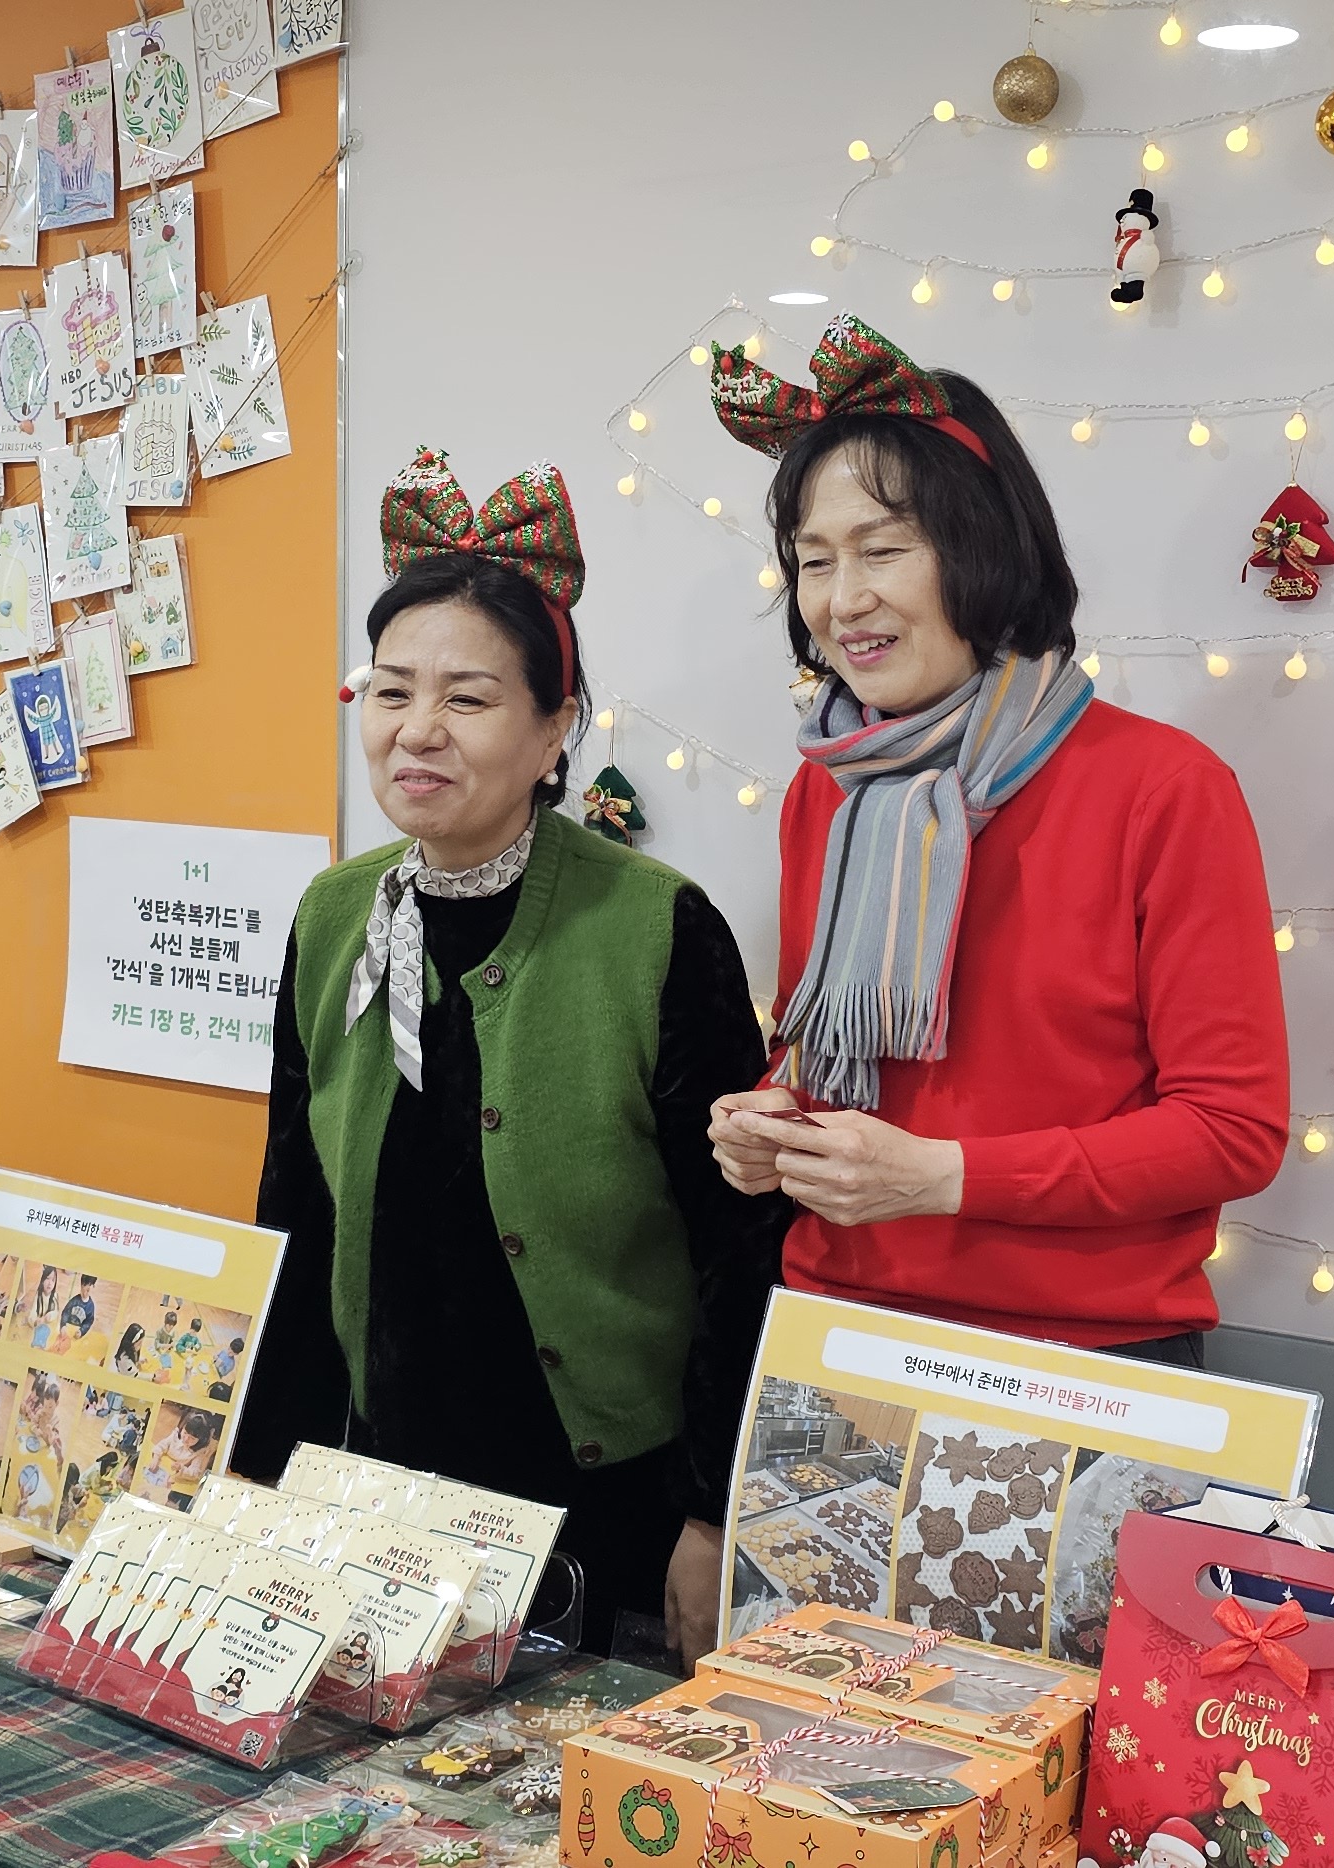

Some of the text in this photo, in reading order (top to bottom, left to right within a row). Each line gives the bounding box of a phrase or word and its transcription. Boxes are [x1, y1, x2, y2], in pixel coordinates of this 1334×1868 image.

[203, 46, 269, 94] CHRISTMAS
[70, 371, 135, 409] JESUS
[138, 379, 183, 397] HBD
[125, 478, 179, 501] JESU
[28, 574, 49, 647] PEACE
[183, 860, 209, 883] 1+1
[133, 896, 262, 933] '성탄축복카드'를
[149, 932, 240, 963] 사신 분들께
[106, 956, 164, 987] '간식'을
[170, 966, 210, 992] 1개씩
[111, 1003, 143, 1026] 카드
[149, 1008, 173, 1033] 1장
[179, 1011, 200, 1040] 당,
[208, 1016, 241, 1042] 간식
[26, 1208, 144, 1249] 유치부에서 준비한 복음 팔찌
[904, 1355, 1131, 1418] 영아부에서 준비한 쿠키 만들기 KIT
[450, 1518, 524, 1545] CHRISTMAS
[469, 1509, 514, 1528] MERRY
[365, 1553, 441, 1587] CHRISTMAS
[386, 1545, 432, 1570] MERRY
[247, 1586, 320, 1622] CHRISTMAS
[268, 1579, 314, 1604] MERRY
[1234, 1688, 1287, 1713] MERRY
[1195, 1698, 1314, 1767] Christmas
